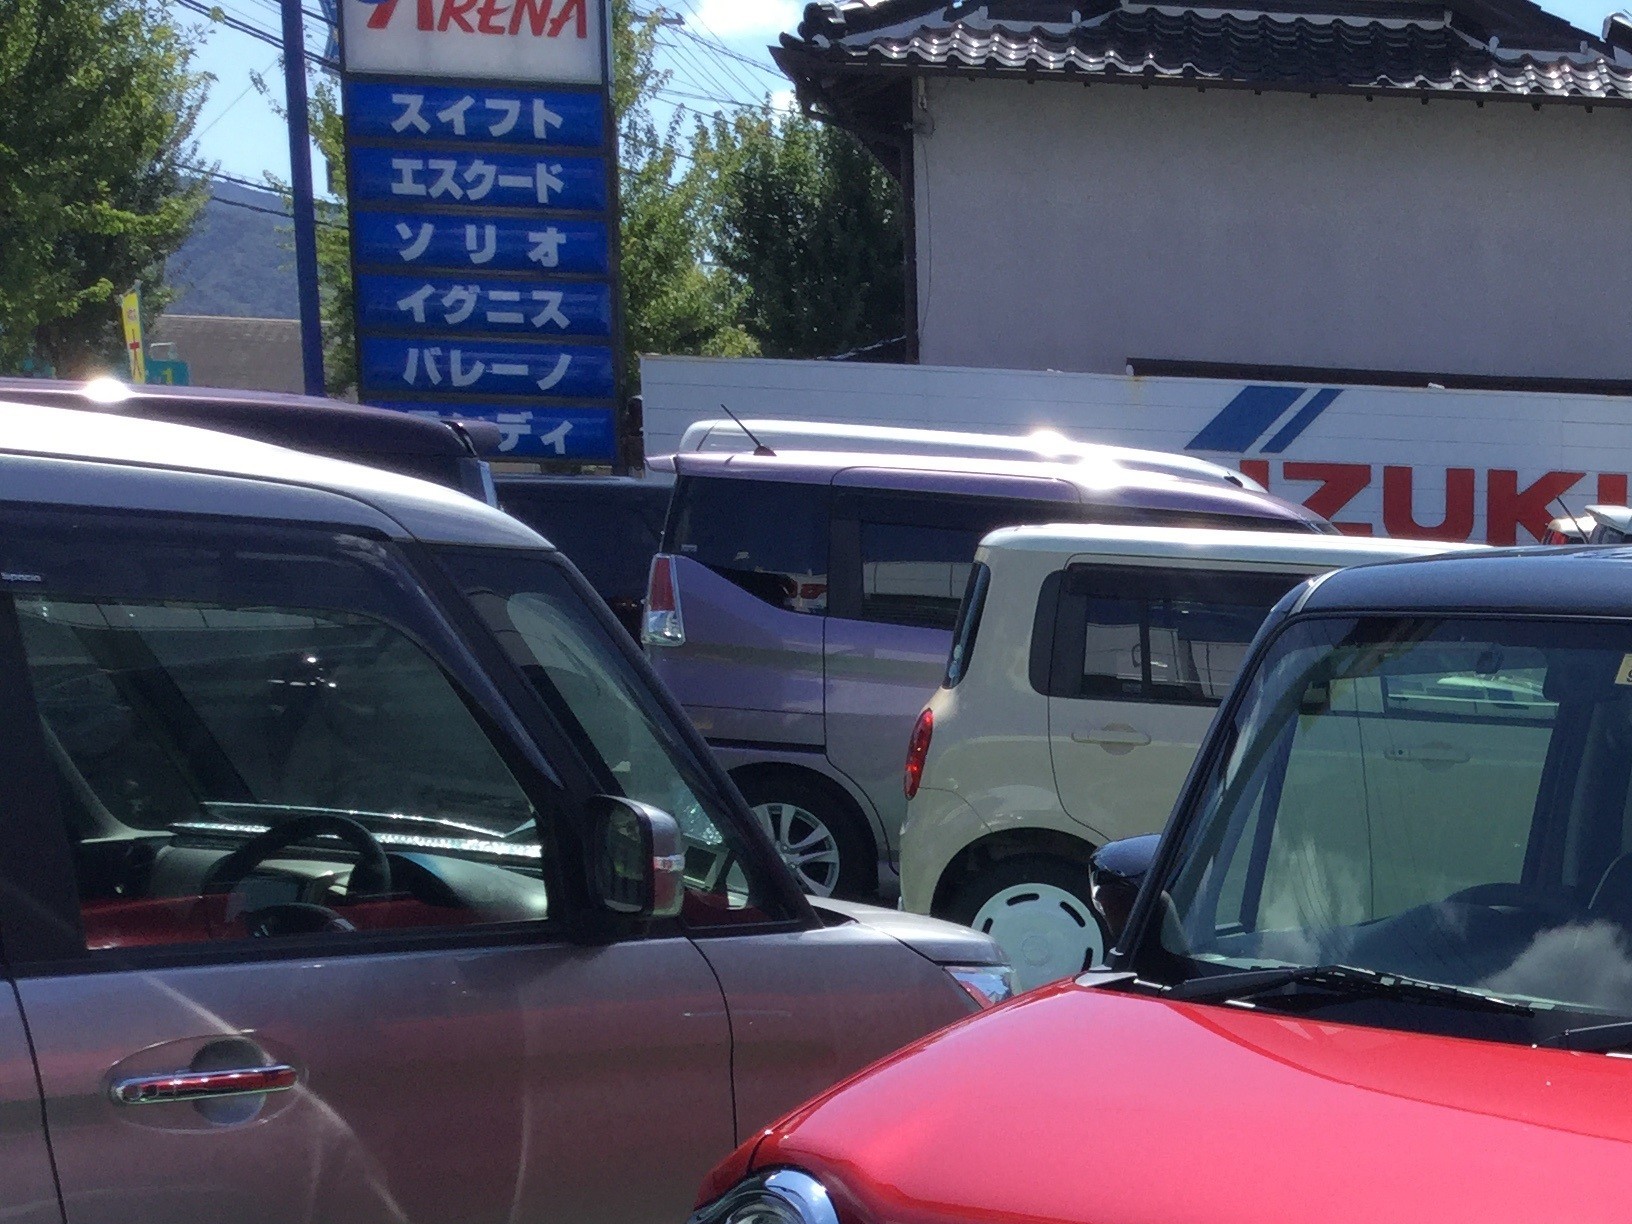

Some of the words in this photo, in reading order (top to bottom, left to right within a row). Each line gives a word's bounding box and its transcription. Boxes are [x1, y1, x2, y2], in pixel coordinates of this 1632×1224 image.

[391, 93, 563, 139] スイフト
[391, 158, 565, 203] エスクード
[395, 222, 567, 267] ソリオ
[397, 284, 570, 329] イグニス
[402, 347, 572, 391] バレーノ
